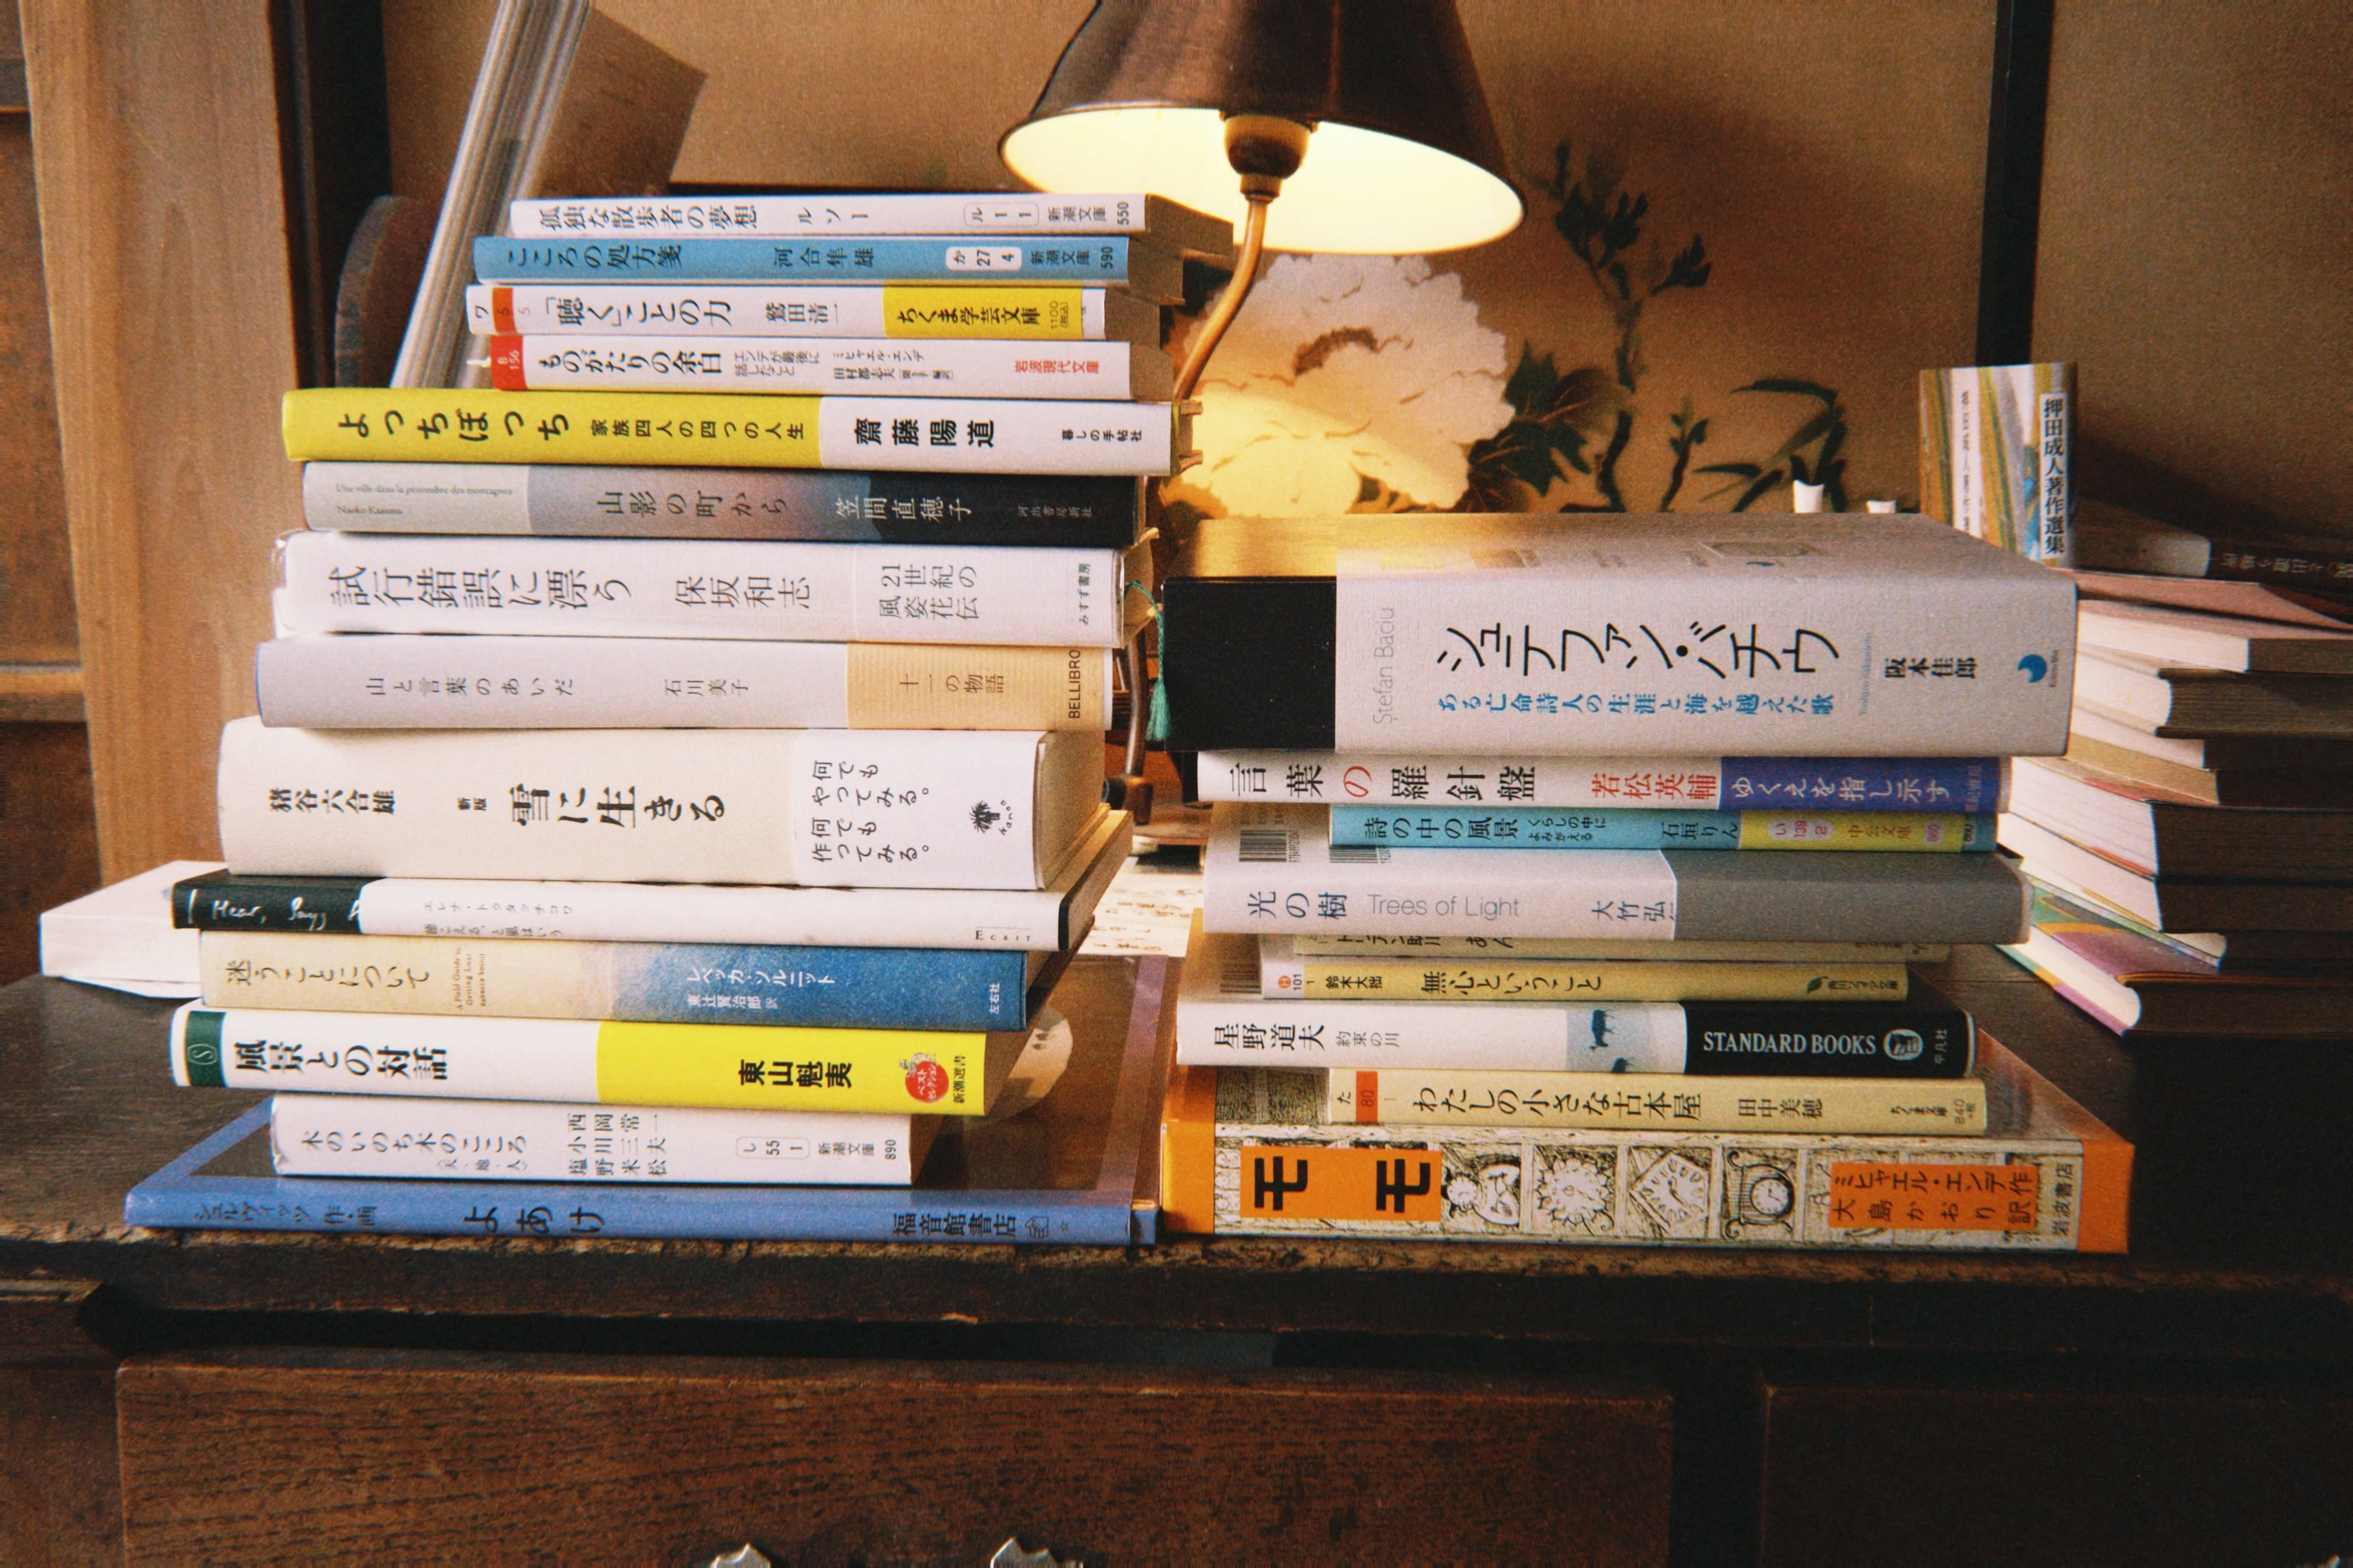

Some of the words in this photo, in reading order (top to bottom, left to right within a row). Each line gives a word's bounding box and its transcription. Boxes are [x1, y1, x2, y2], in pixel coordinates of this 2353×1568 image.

[540, 205, 757, 230] 孤独な散歩者の夢想
[798, 207, 869, 227] ルソー
[1048, 206, 1105, 221] 新潮文庫
[1117, 202, 1129, 225] 550
[509, 245, 681, 268] こころの処方箋
[774, 247, 874, 267] 河合隼雄
[954, 251, 965, 264] か
[977, 250, 990, 266] 27
[1002, 253, 1014, 262] 4
[1030, 250, 1090, 266] 新潮文庫
[1100, 246, 1114, 269] 590
[547, 298, 731, 326] 「聴く」ことの力
[766, 303, 838, 323] 鷲田清一
[899, 307, 1040, 324] ちくま学芸文庫
[1050, 300, 1058, 330] 1100
[510, 350, 521, 371] 156
[539, 350, 722, 374] ものがたりの余白
[1014, 360, 1099, 374] 岩波現代文庫
[339, 409, 569, 441] よっちぼっち
[591, 420, 803, 439] 家族四人の四つの人生
[1062, 430, 1141, 442] 暮しの手帖社
[2043, 398, 2066, 555] 押田成人著作選集
[596, 490, 787, 518] 山影の町から
[835, 497, 973, 522] 笠間直穂子
[328, 567, 630, 609] 試行錯誤に漂う
[882, 565, 976, 588] 21世紀の
[675, 576, 809, 609] 保坂和志
[1079, 564, 1090, 625] みすず書房
[879, 597, 978, 619] 風姿花伝
[1437, 621, 1839, 679] シュテファン・バチウ
[1884, 656, 1977, 679] 阪本佳郎
[366, 678, 572, 696] 山と言葉のあいだ
[665, 680, 748, 696] 石川美子
[900, 674, 1004, 693] 十一の物語
[1069, 648, 1082, 718] BELLIBRO
[1439, 694, 1834, 715] ある亡命詩人の生涯と海を越えた歌
[813, 761, 878, 780] 何でも
[1229, 761, 1535, 802] 言葉の羅針盤
[812, 787, 929, 807] やってみる。
[1591, 773, 1718, 802] 若松英輔
[1731, 777, 1949, 802] ゆくえを指し示す
[458, 799, 486, 810] 新版
[510, 784, 724, 827] 雪に生きる
[811, 818, 876, 837] 何でも
[1365, 817, 1518, 839] 詩の中の風景
[1529, 817, 1605, 829] くらしの中に
[1661, 822, 1739, 840] 石垣りん
[1848, 824, 1913, 839] 中公文庫
[813, 844, 929, 863] 作ってみる。
[1248, 892, 1347, 919] 光の樹
[1368, 894, 1427, 915] Trees
[1436, 896, 1457, 916] of
[1465, 897, 1519, 919] Light
[226, 960, 429, 988] 迷うことについて
[687, 965, 835, 988] レベッカ・ソルニット
[1293, 972, 1302, 991] 101
[1326, 977, 1382, 988] 鈴木大拙
[1421, 971, 1601, 994] 無心ということ
[989, 983, 999, 1015] 左右社
[1215, 1024, 1324, 1050] 星野道夫
[1336, 1032, 1399, 1047] 約束の川
[1704, 1032, 1806, 1053] STANDARD
[1812, 1035, 1875, 1054] BOOKS
[1934, 1029, 1947, 1064] 平凡社
[234, 1040, 447, 1080] 風景との対話
[739, 1060, 851, 1087] 東山魁夷
[953, 1054, 967, 1103] 新潮選書
[1337, 1092, 1351, 1104] た
[1360, 1089, 1375, 1108] 80
[1413, 1087, 1701, 1120] わたしの小さな古本屋
[1739, 1096, 1822, 1119] 田中美穂
[1889, 1105, 1948, 1119] ちくま文庫
[1953, 1097, 1965, 1124] 840
[569, 1112, 659, 1133] 西岡常一
[301, 1131, 525, 1153] 木のいのち木のこころ
[568, 1136, 665, 1153] 小川三夫
[766, 1140, 779, 1155] 55
[819, 1143, 874, 1155] 新潮文庫
[885, 1139, 897, 1161] 890
[569, 1159, 667, 1176] 塩野米松
[1255, 1156, 1430, 1213] モモ
[1835, 1170, 2036, 1197] ミヒャエル・エンデ作
[2052, 1161, 2074, 1236] 岩波書店
[464, 1204, 606, 1236] よあけ
[1832, 1198, 2034, 1224] 大島かおり訳
[892, 1212, 1018, 1237] 福音館書店
